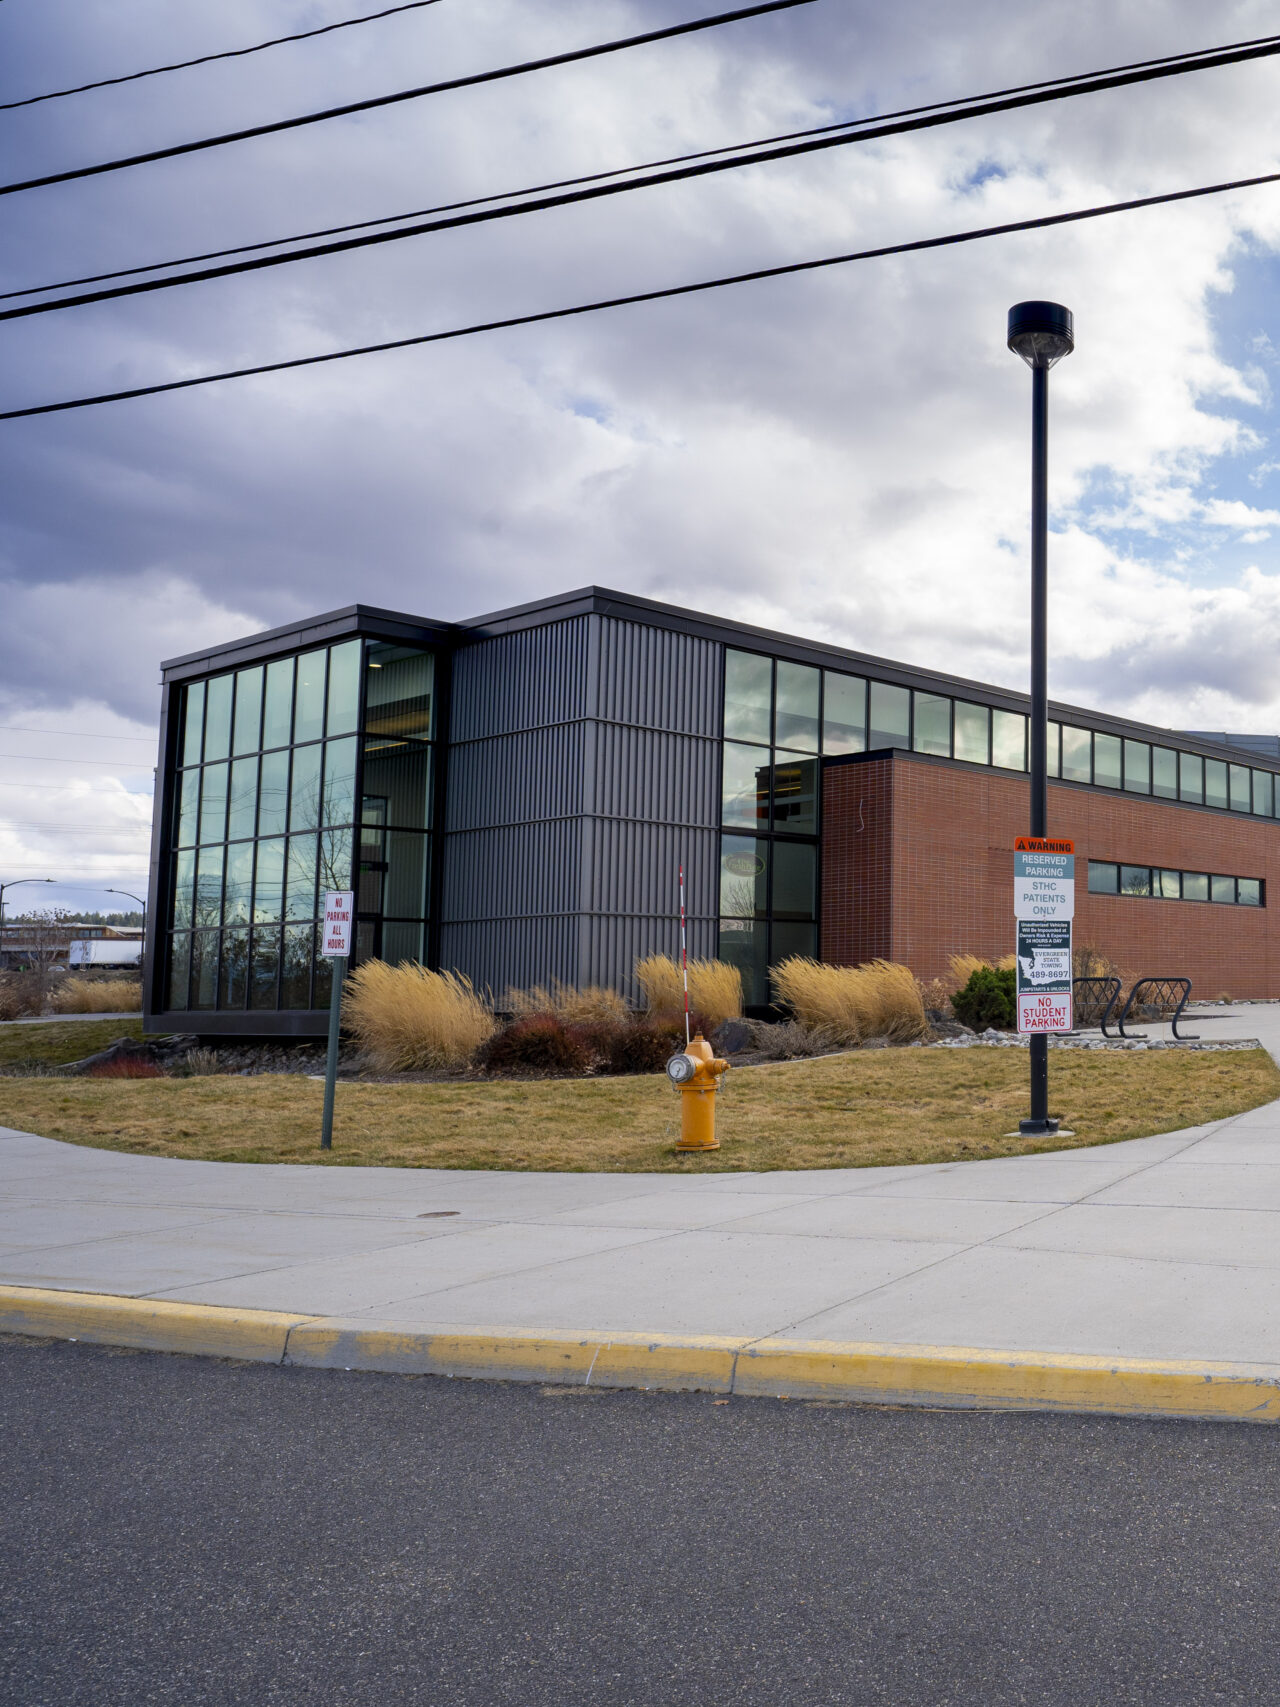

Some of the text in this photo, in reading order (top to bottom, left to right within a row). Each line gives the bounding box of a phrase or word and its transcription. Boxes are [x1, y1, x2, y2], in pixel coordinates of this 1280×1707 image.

[1028, 841, 1071, 852] WARNING
[1022, 854, 1067, 865] RESERVED
[1025, 866, 1063, 877] PARKING
[1032, 881, 1057, 891] STHC
[335, 898, 343, 908] NO
[1023, 893, 1066, 903] PATIENTS
[1032, 906, 1056, 915] ONLY
[326, 911, 350, 921] PARKING
[332, 925, 342, 935] ALL
[327, 939, 345, 949] HOURS
[1030, 970, 1069, 978] 489-8697
[1037, 997, 1052, 1007] NO
[1023, 1007, 1067, 1018] STUDENT
[1025, 1017, 1065, 1028] PARKING
